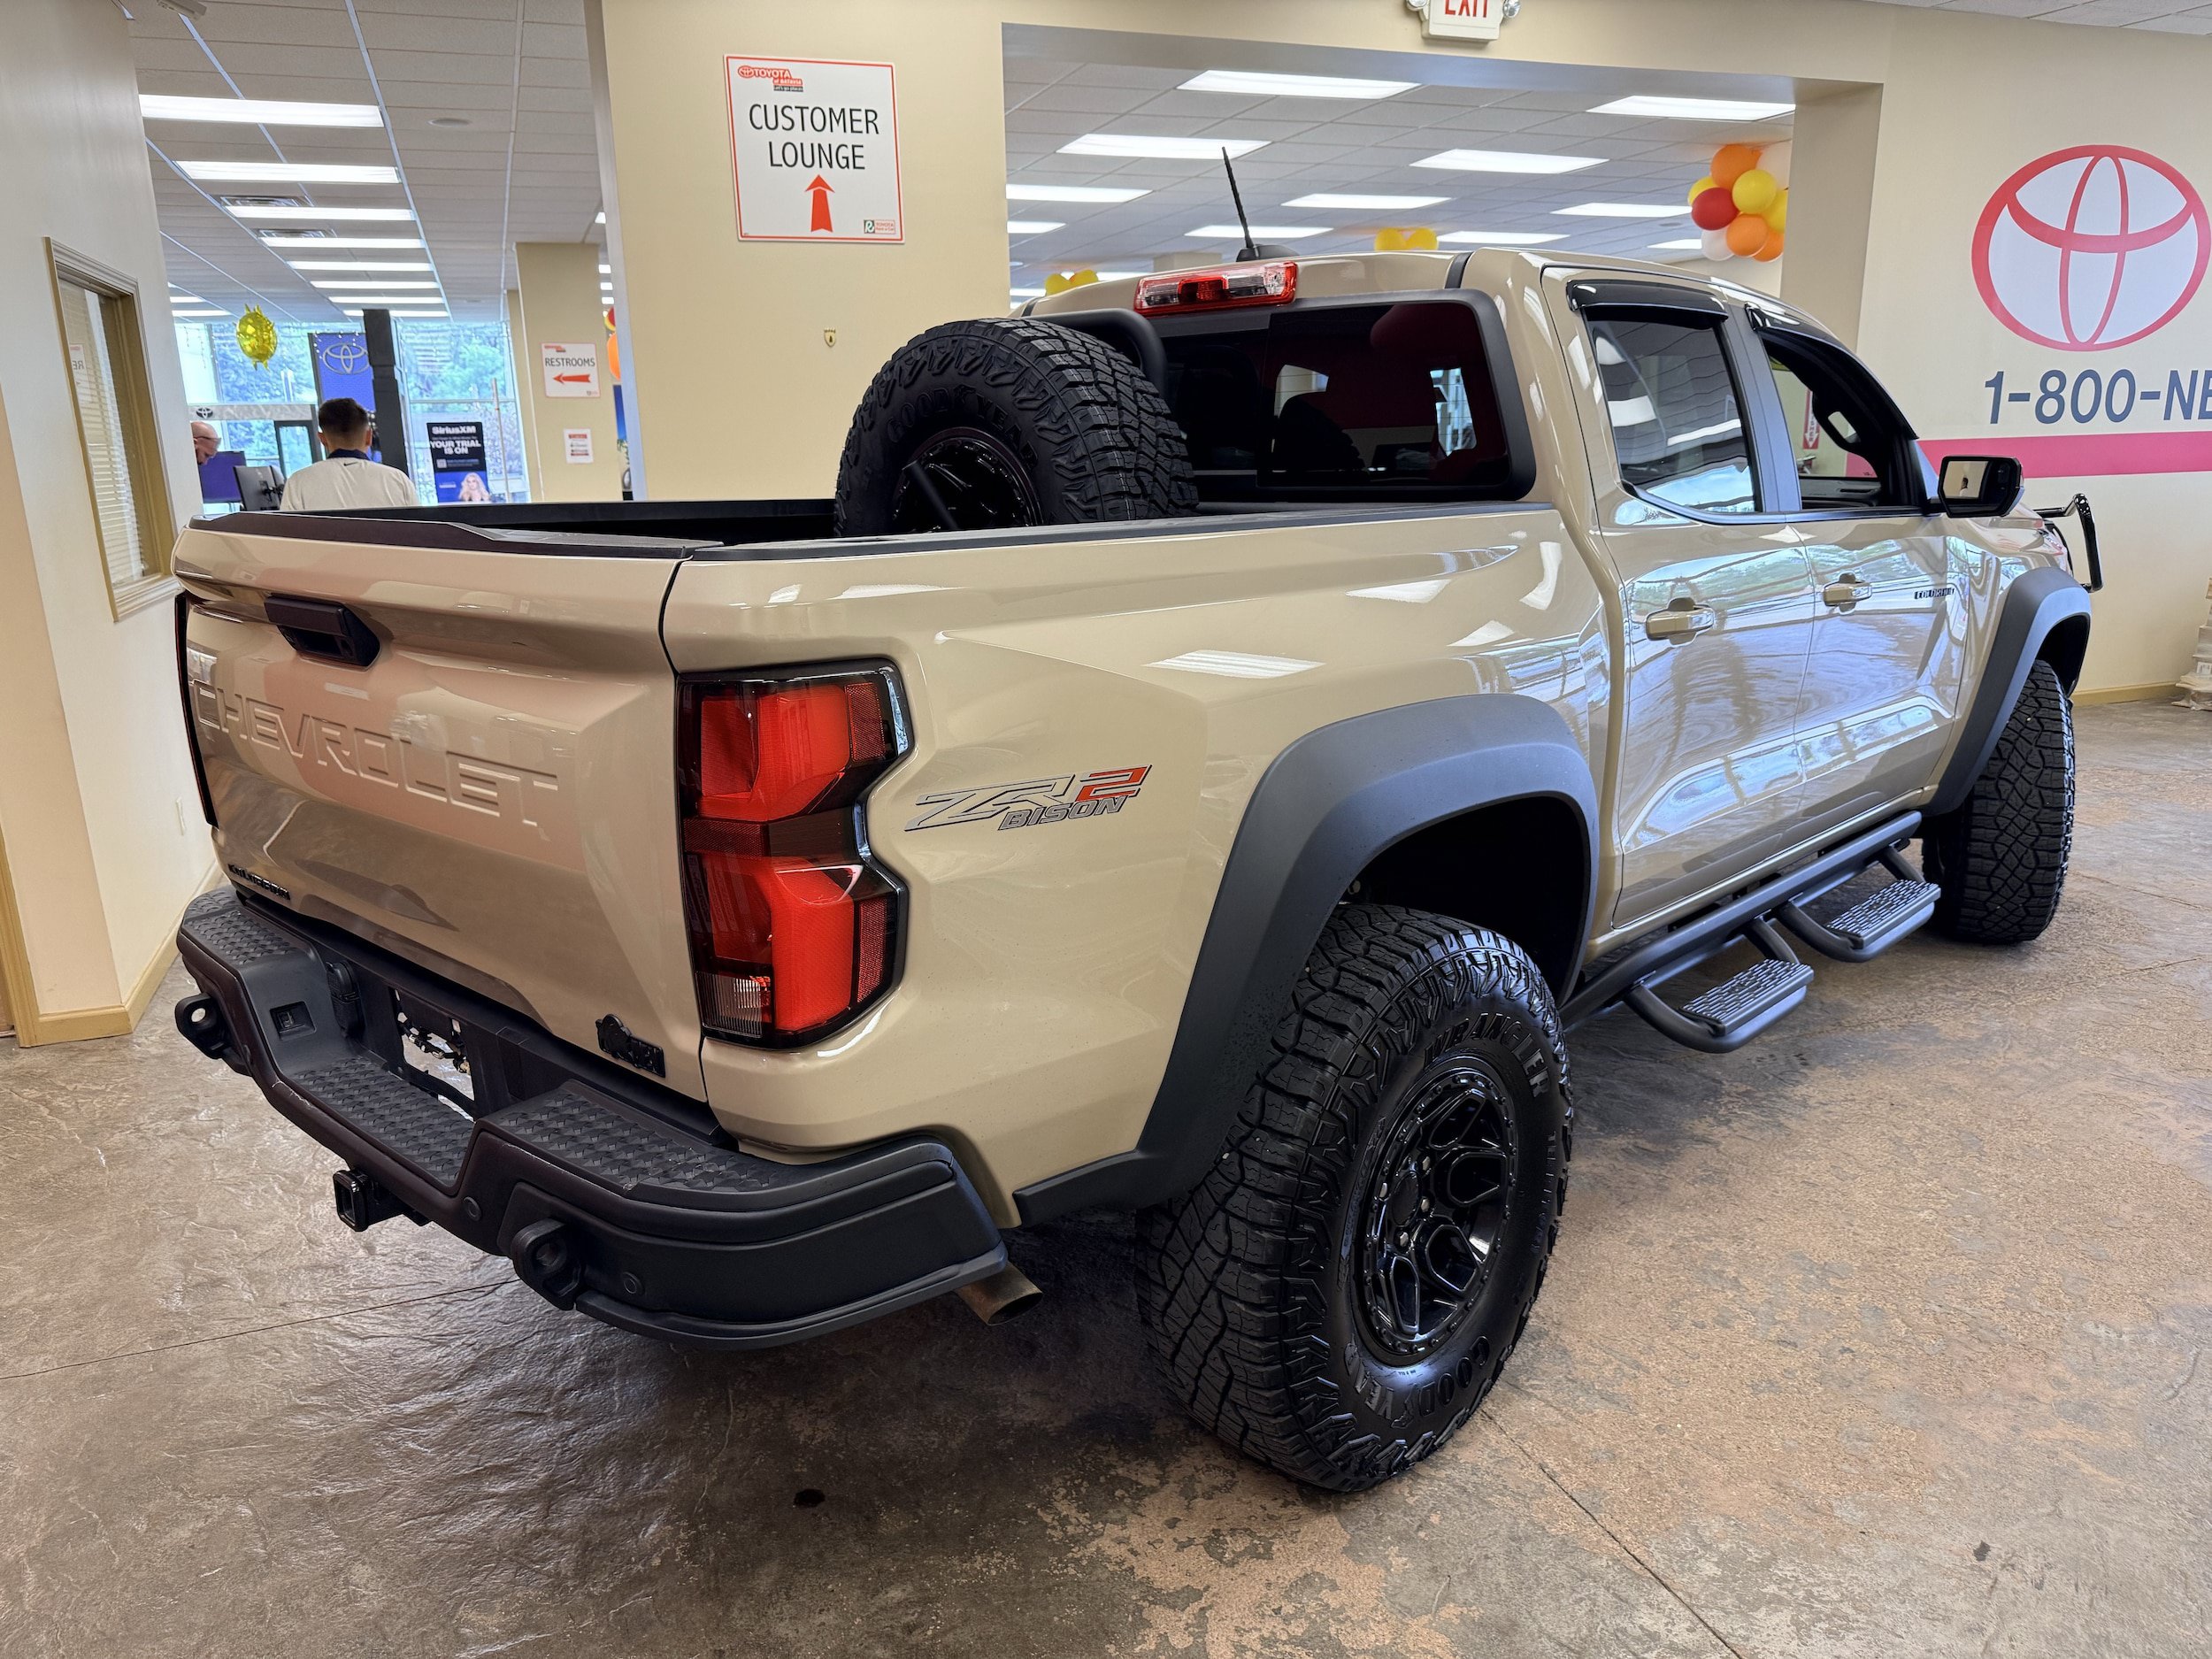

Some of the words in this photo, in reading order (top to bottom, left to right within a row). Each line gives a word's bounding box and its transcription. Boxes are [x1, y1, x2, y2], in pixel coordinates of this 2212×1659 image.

[754, 68, 791, 78] TOYOTA
[749, 104, 879, 134] CUSTOMER
[768, 141, 865, 170] LOUNGE
[544, 357, 595, 367] RESTROOMS
[430, 440, 455, 449] YOUR
[432, 426, 476, 434] SiriusXM
[191, 679, 559, 826] CHEVROLET
[904, 764, 1152, 832] ZR2
[997, 794, 1129, 831] BISON
[1424, 1012, 1549, 1099] WRANGLER
[1344, 1334, 1490, 1421] GOODYEAR
